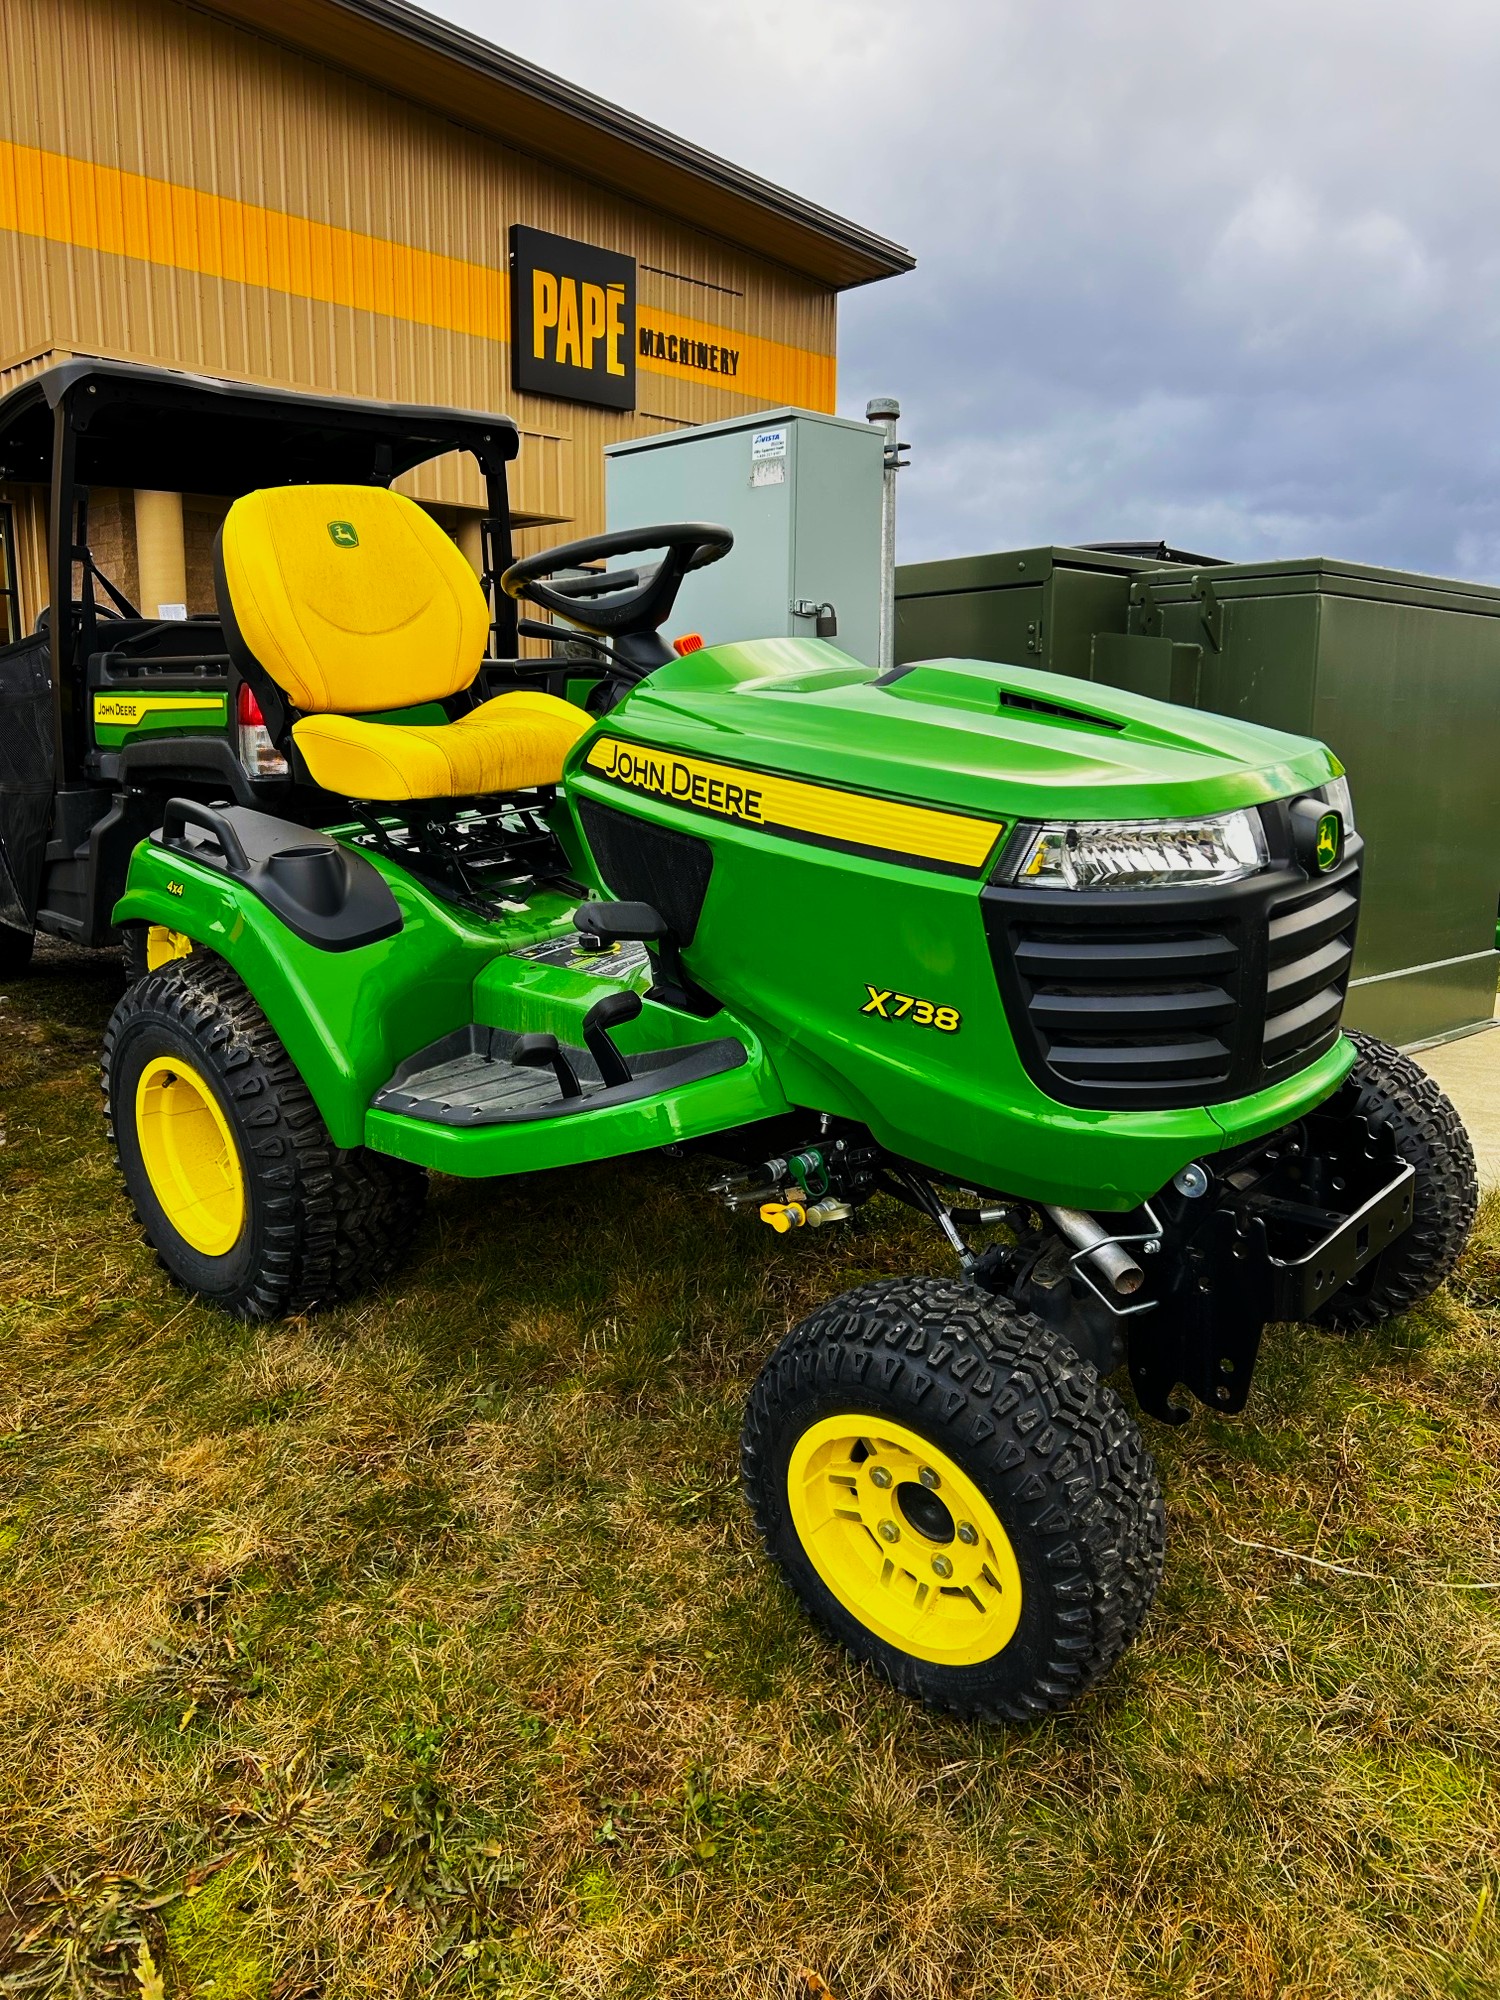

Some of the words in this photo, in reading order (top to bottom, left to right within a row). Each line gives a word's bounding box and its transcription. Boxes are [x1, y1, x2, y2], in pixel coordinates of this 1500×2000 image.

[532, 268, 625, 377] PAPÉ
[639, 327, 740, 376] MACHINERY
[98, 702, 115, 716] JOHN
[115, 703, 137, 717] DEERE
[605, 744, 666, 791] JOHN
[671, 762, 763, 820] DEERE
[166, 880, 184, 896] 4x4
[861, 985, 961, 1032] X738
